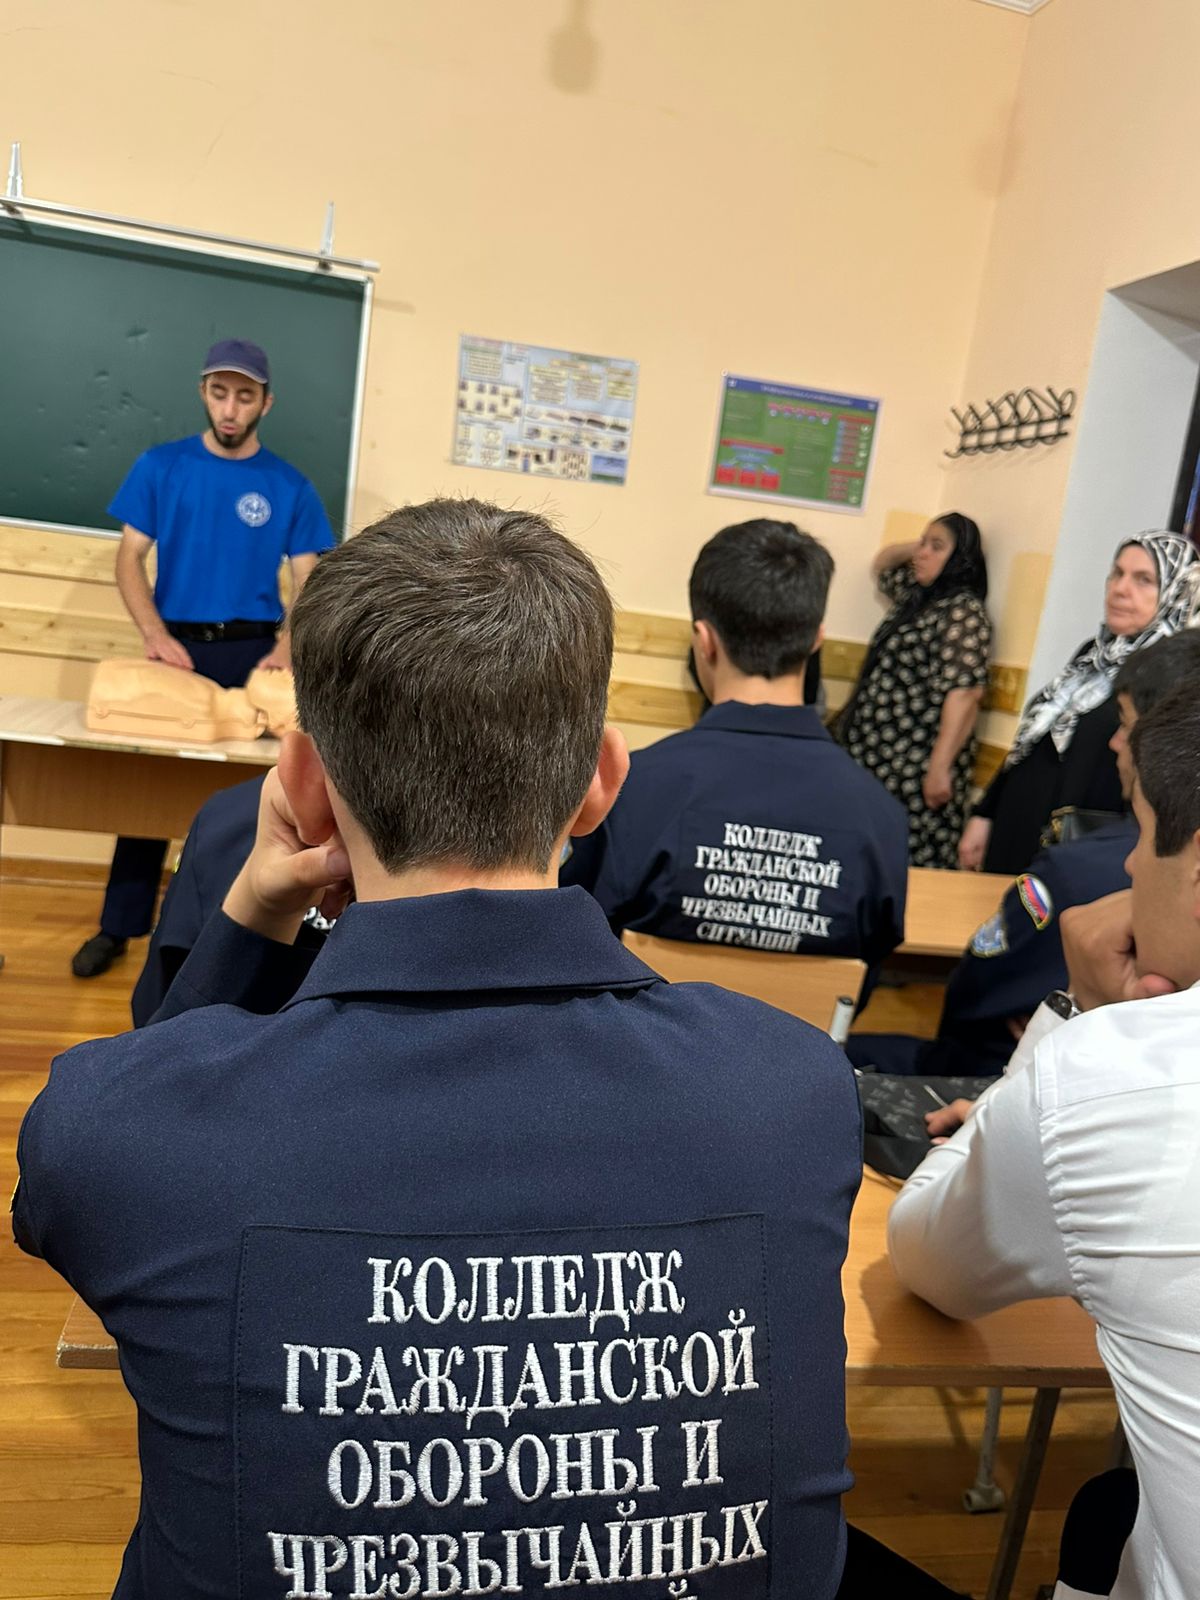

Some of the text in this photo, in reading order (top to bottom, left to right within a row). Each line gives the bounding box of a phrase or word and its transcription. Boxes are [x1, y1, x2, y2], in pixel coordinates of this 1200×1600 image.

[694, 845, 843, 889] ГРАЖДАНСКОЙ
[723, 822, 823, 859] КОЛЛЕДЖ
[681, 896, 833, 938] ЧРЕЗВЫЧАЙНЫХ
[703, 873, 822, 911] ОБОРОНЫ И
[367, 1249, 686, 1334] КОЛЛЕДЖ
[281, 1307, 760, 1430] ГРАЖДАНСКОЙ
[327, 1419, 724, 1510] ОБОРОНЫ И
[266, 1499, 769, 1600] ЧРЕЗВЫЧАЙНЫХ
